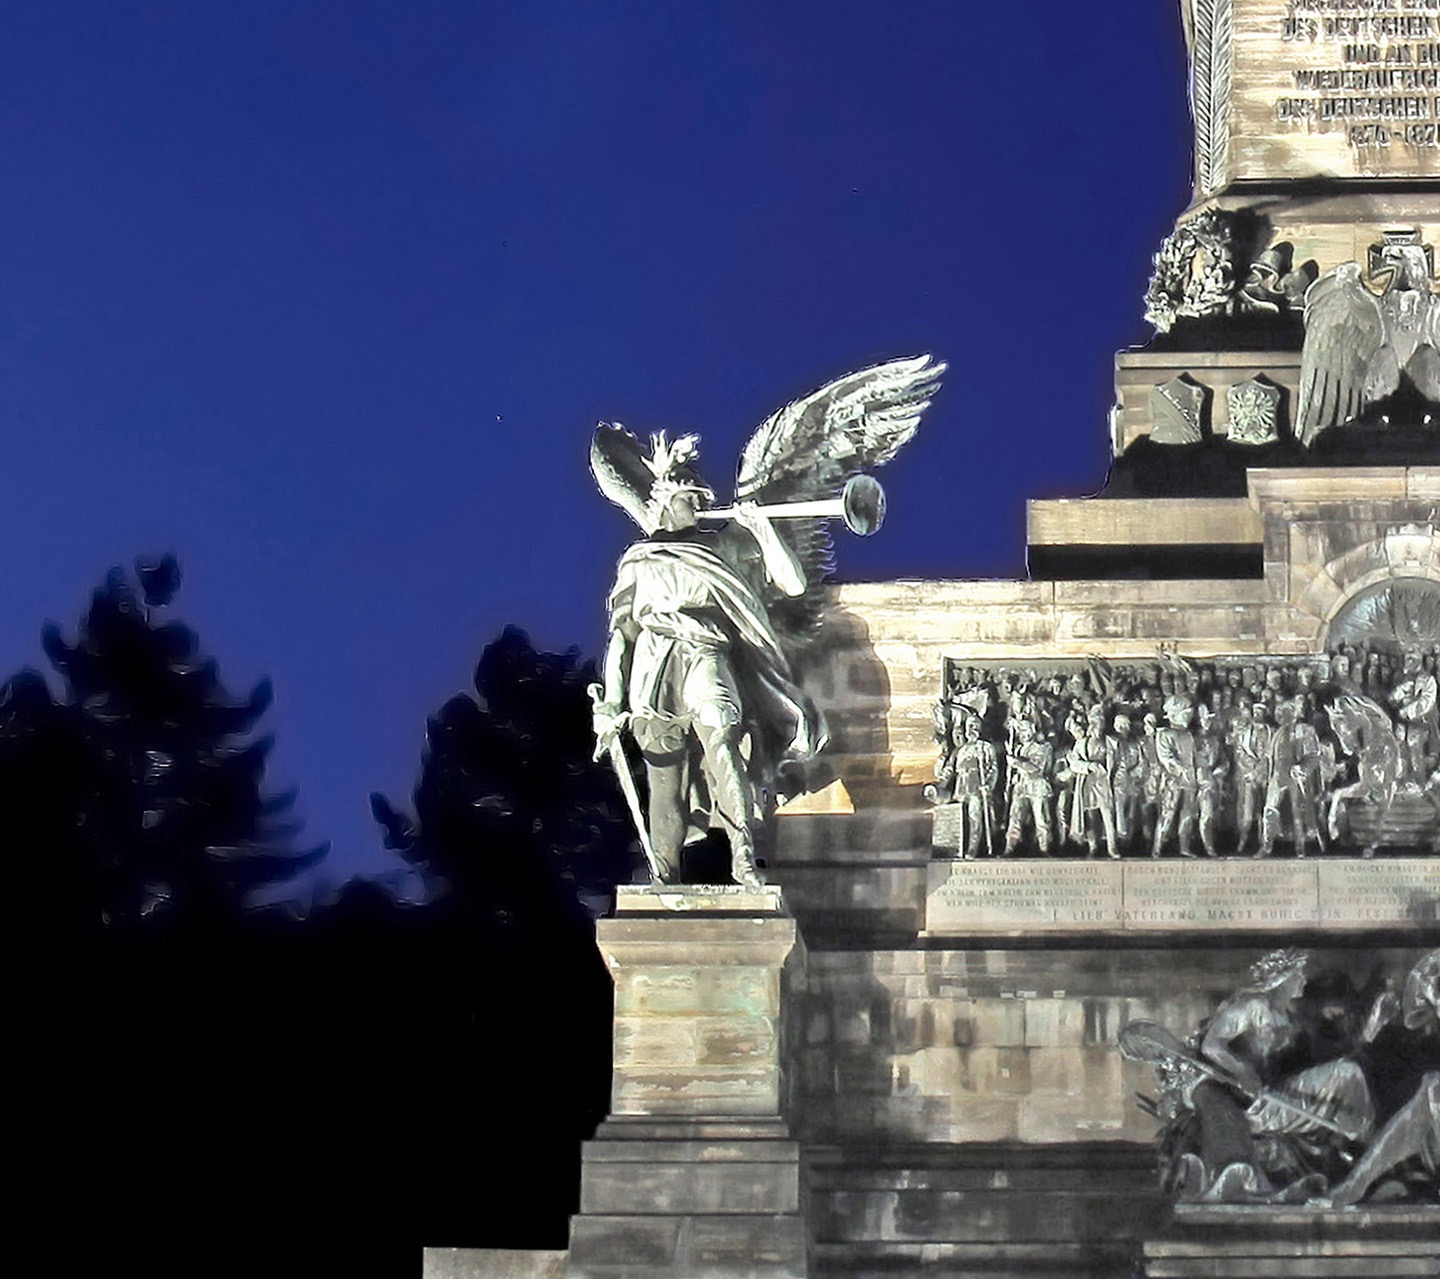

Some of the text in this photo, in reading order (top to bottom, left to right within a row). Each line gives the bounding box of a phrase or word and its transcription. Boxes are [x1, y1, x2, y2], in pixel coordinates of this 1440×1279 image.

[1282, 16, 1318, 38] DES
[1322, 16, 1433, 38] DEUTSCHEN
[1343, 43, 1380, 63] UND
[1385, 43, 1412, 63] AN
[1276, 97, 1317, 119] DES
[1319, 97, 1430, 119] DEUTSCHEN
